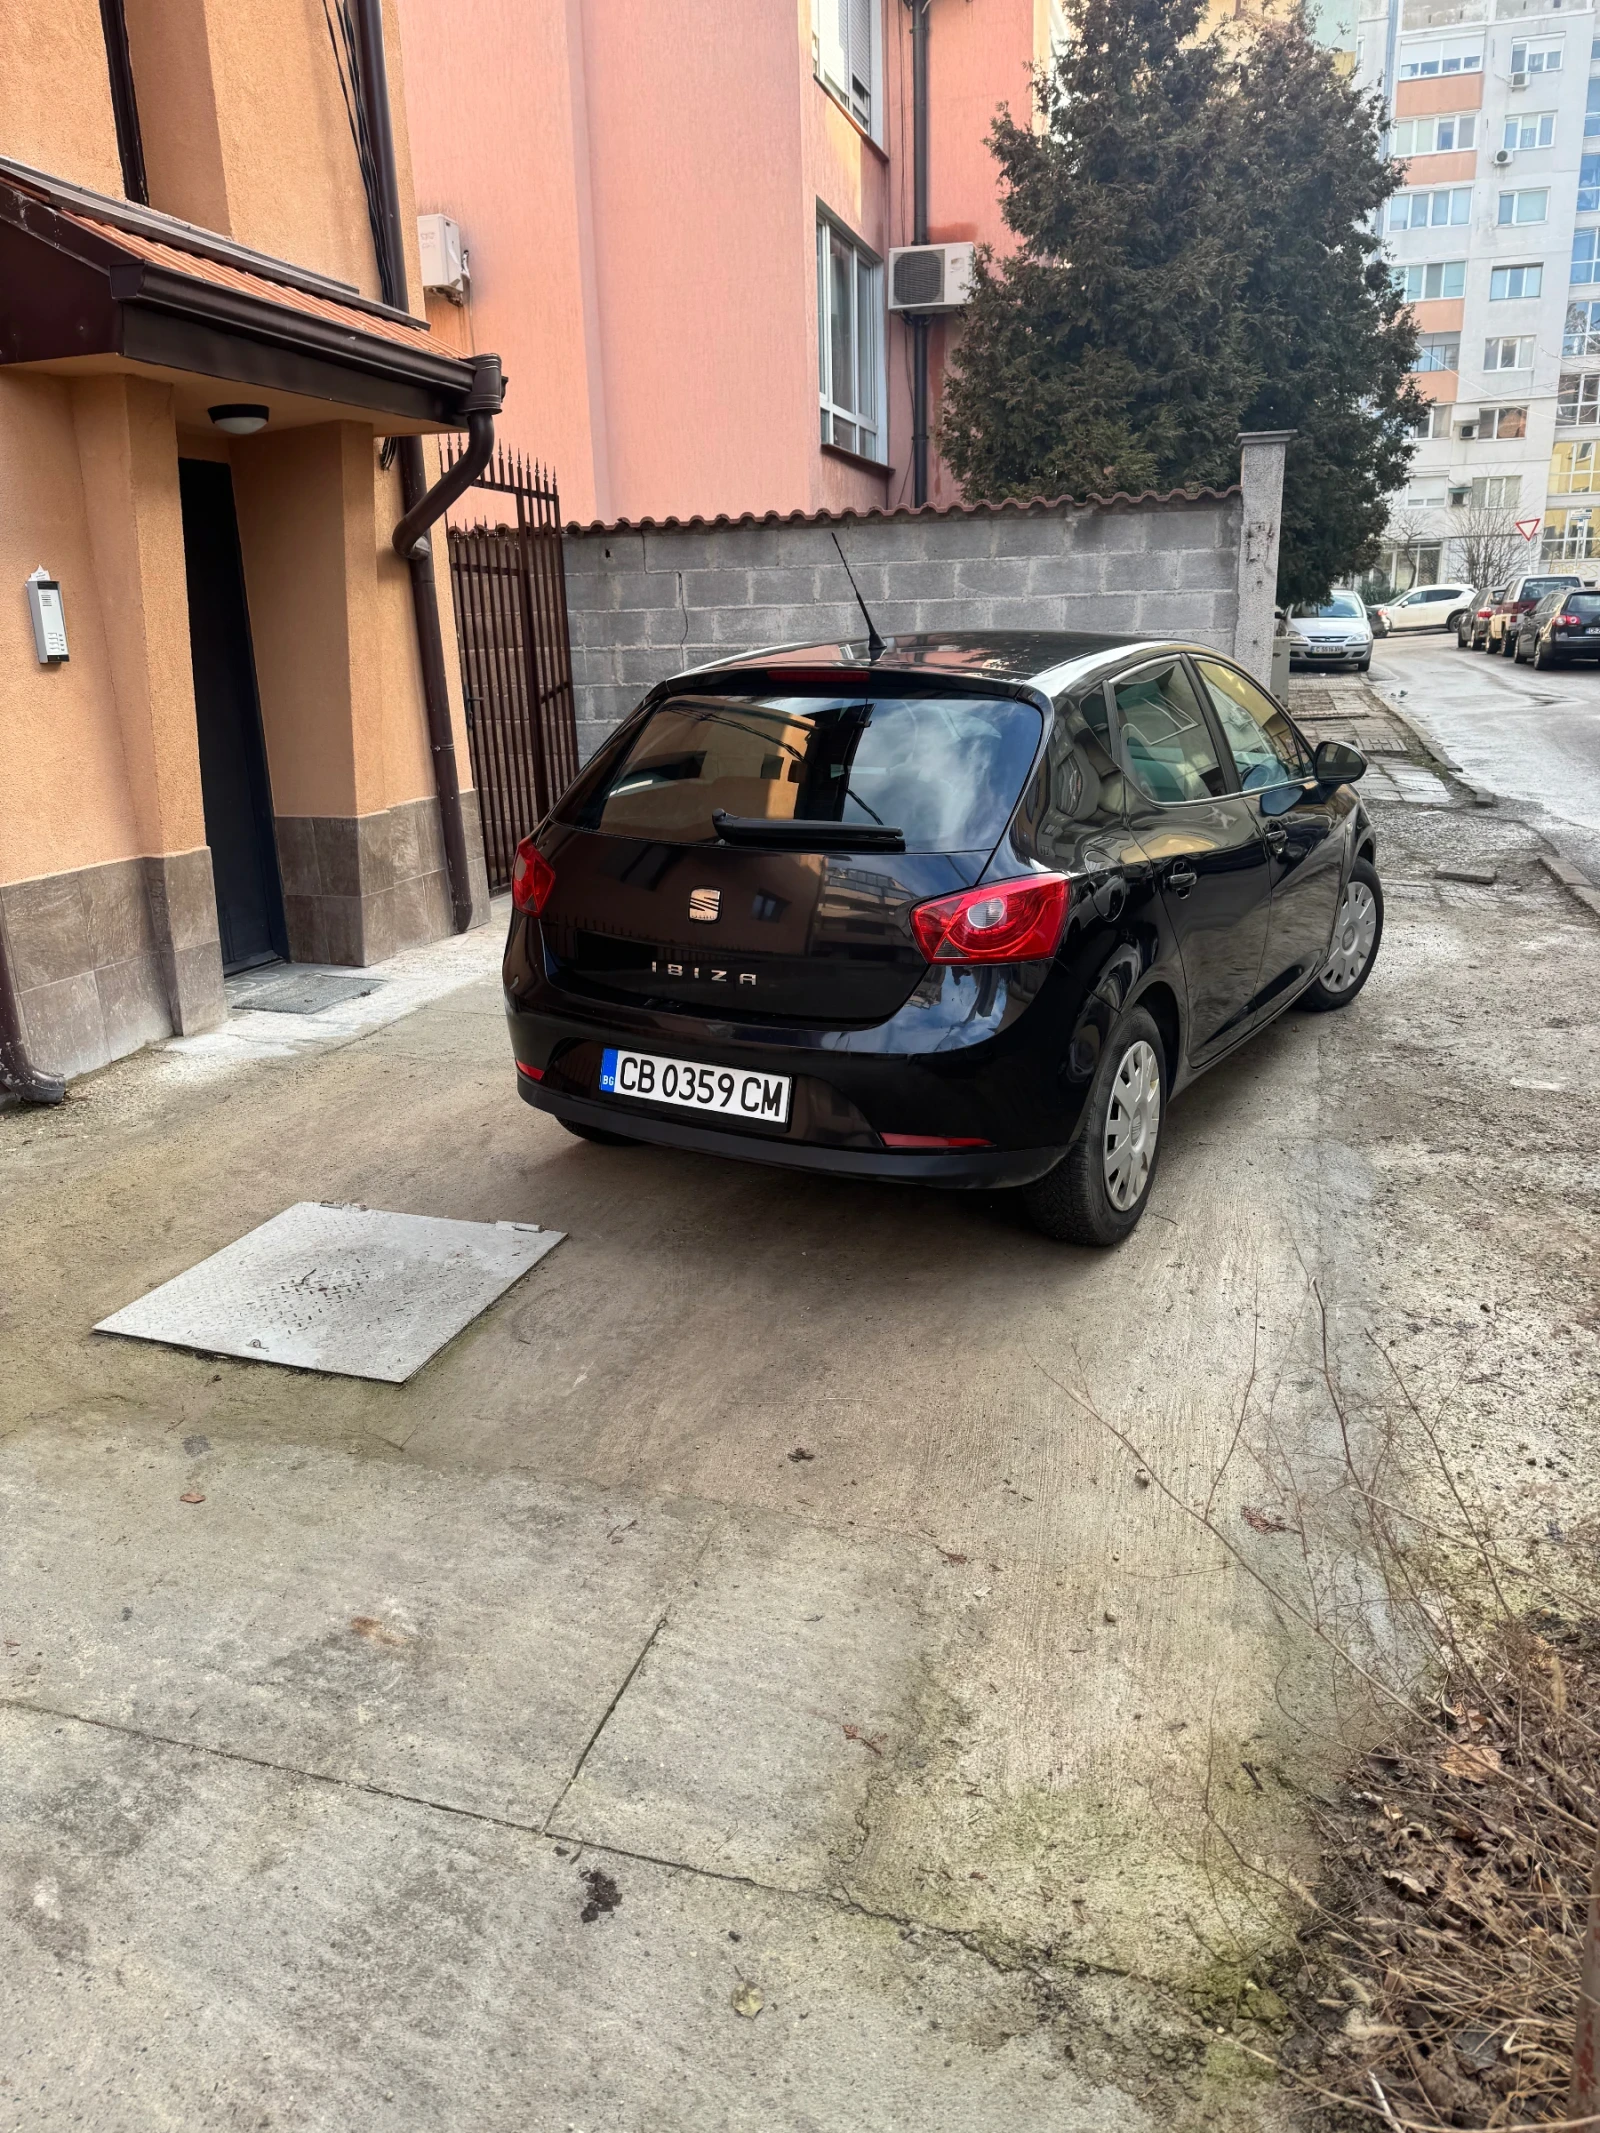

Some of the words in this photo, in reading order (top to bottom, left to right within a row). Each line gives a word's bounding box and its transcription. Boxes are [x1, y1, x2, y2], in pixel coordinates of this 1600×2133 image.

[651, 961, 757, 985] IBIZA
[602, 1075, 614, 1086] BG
[619, 1057, 655, 1093] CB
[661, 1064, 735, 1108] 0359
[740, 1077, 783, 1117] CM
